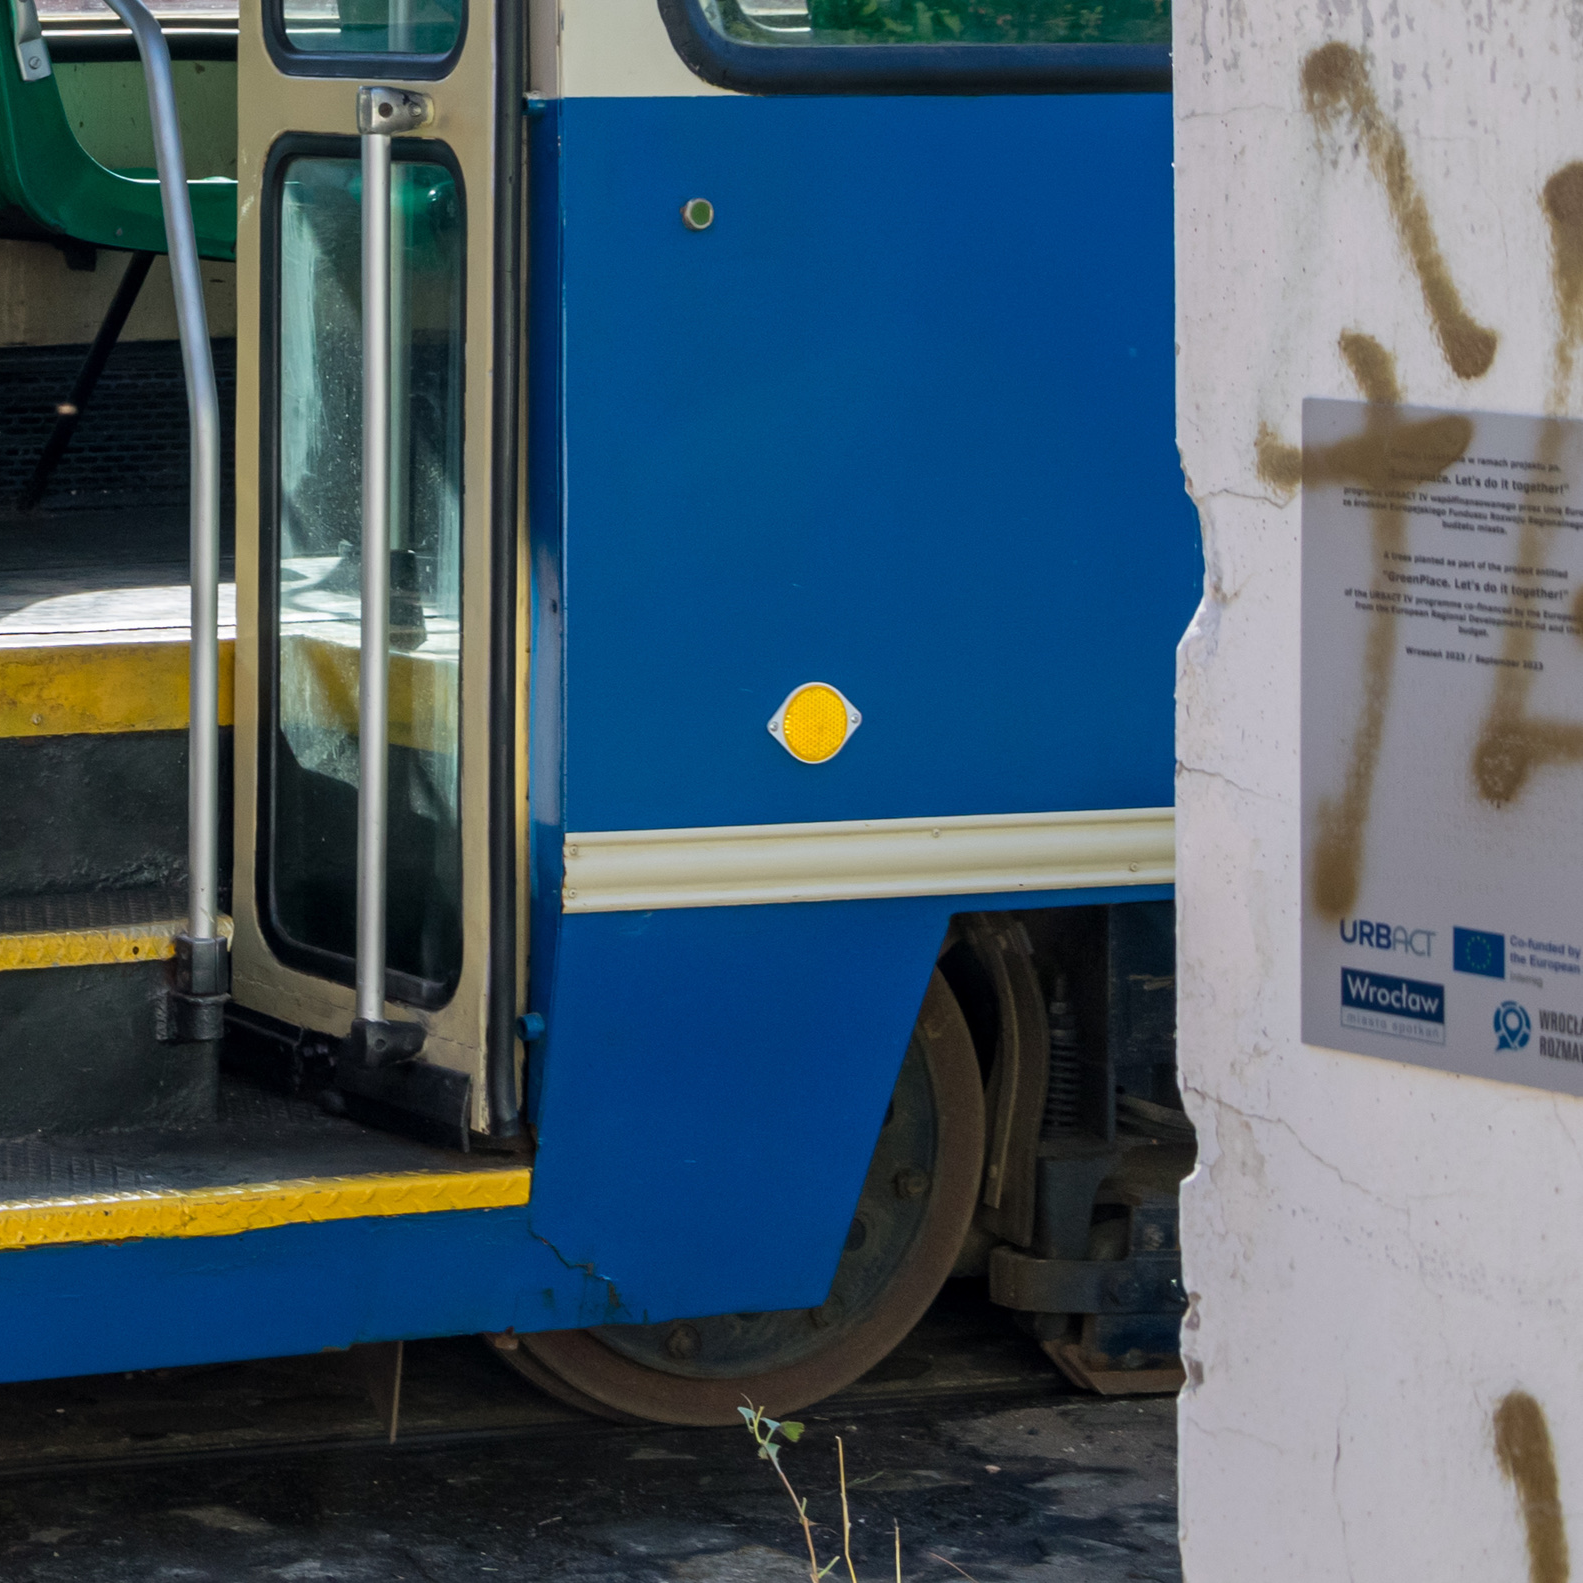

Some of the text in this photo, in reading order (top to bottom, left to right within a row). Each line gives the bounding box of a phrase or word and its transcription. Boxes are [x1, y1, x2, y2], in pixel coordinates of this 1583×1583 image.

[1455, 474, 1481, 487] Let's
[1484, 476, 1498, 489] do
[1500, 478, 1509, 490] it
[1454, 578, 1481, 592] Let's
[1483, 580, 1497, 593] do
[1500, 582, 1508, 595] it
[1340, 919, 1437, 958] URBACT
[1568, 944, 1582, 960] by
[1529, 954, 1581, 974] European
[1347, 974, 1439, 1015] Wrocław
[1346, 1013, 1387, 1029] miasto
